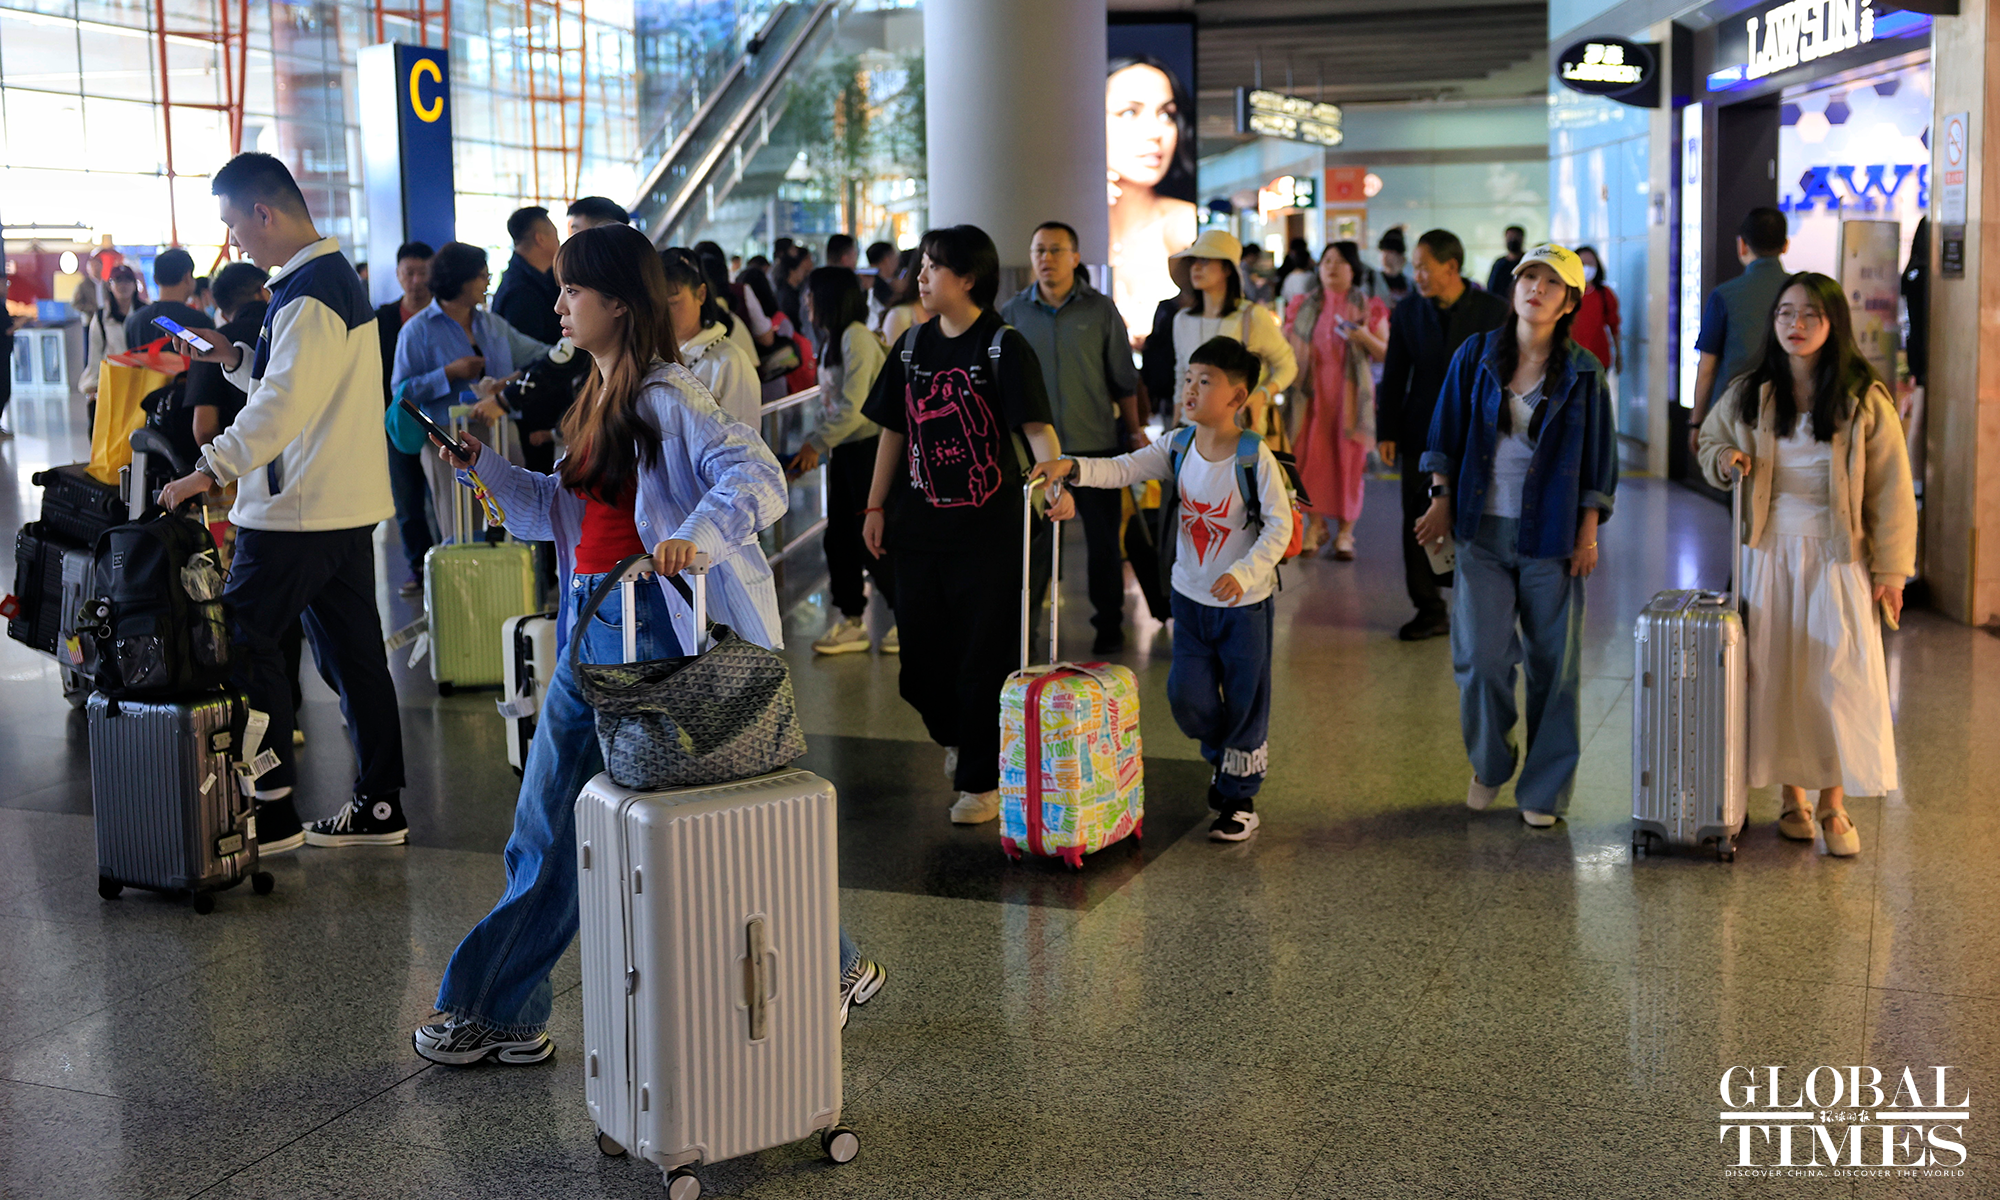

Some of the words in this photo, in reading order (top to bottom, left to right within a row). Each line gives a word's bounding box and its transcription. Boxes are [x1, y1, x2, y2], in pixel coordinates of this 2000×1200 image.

[1746, 0, 1859, 80] LAWSON
[409, 58, 444, 123] C
[1046, 737, 1077, 758] YORK
